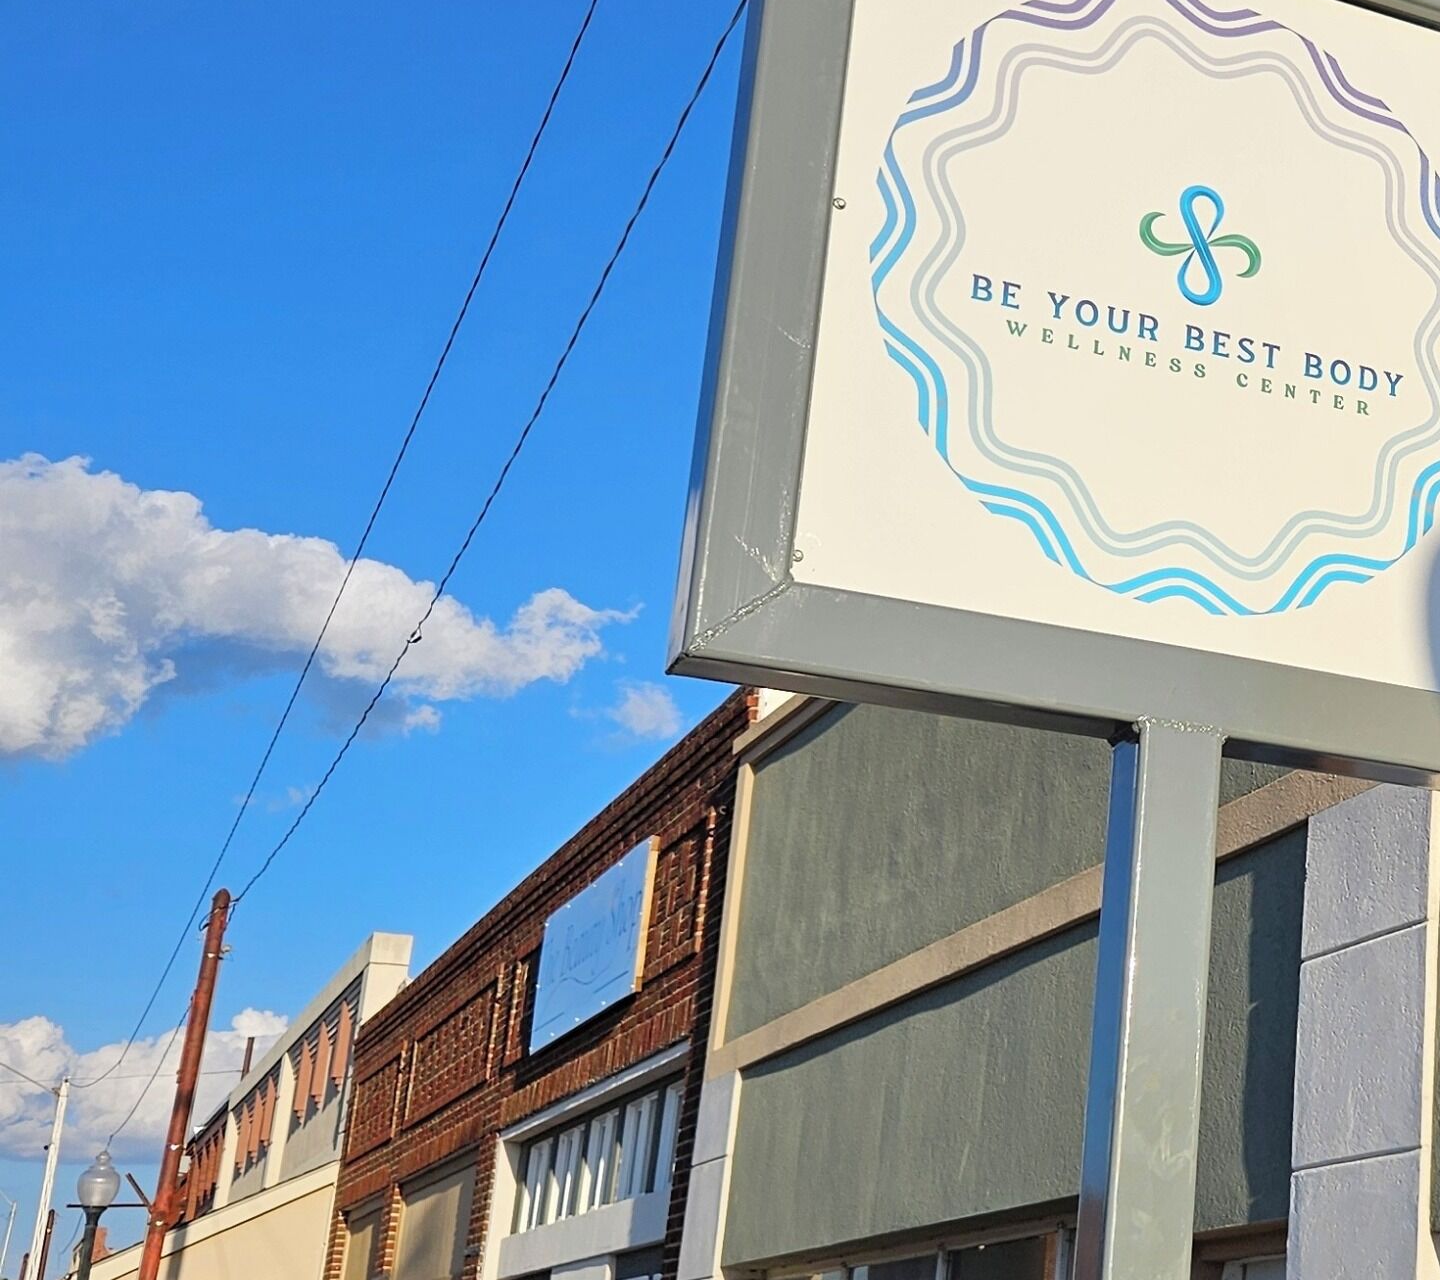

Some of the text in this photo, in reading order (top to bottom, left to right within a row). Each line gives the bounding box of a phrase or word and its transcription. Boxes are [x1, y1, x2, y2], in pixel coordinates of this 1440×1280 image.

[970, 273, 1405, 398] BE YOUR BEST BODY
[1006, 319, 1371, 416] WELLNESS CENTER
